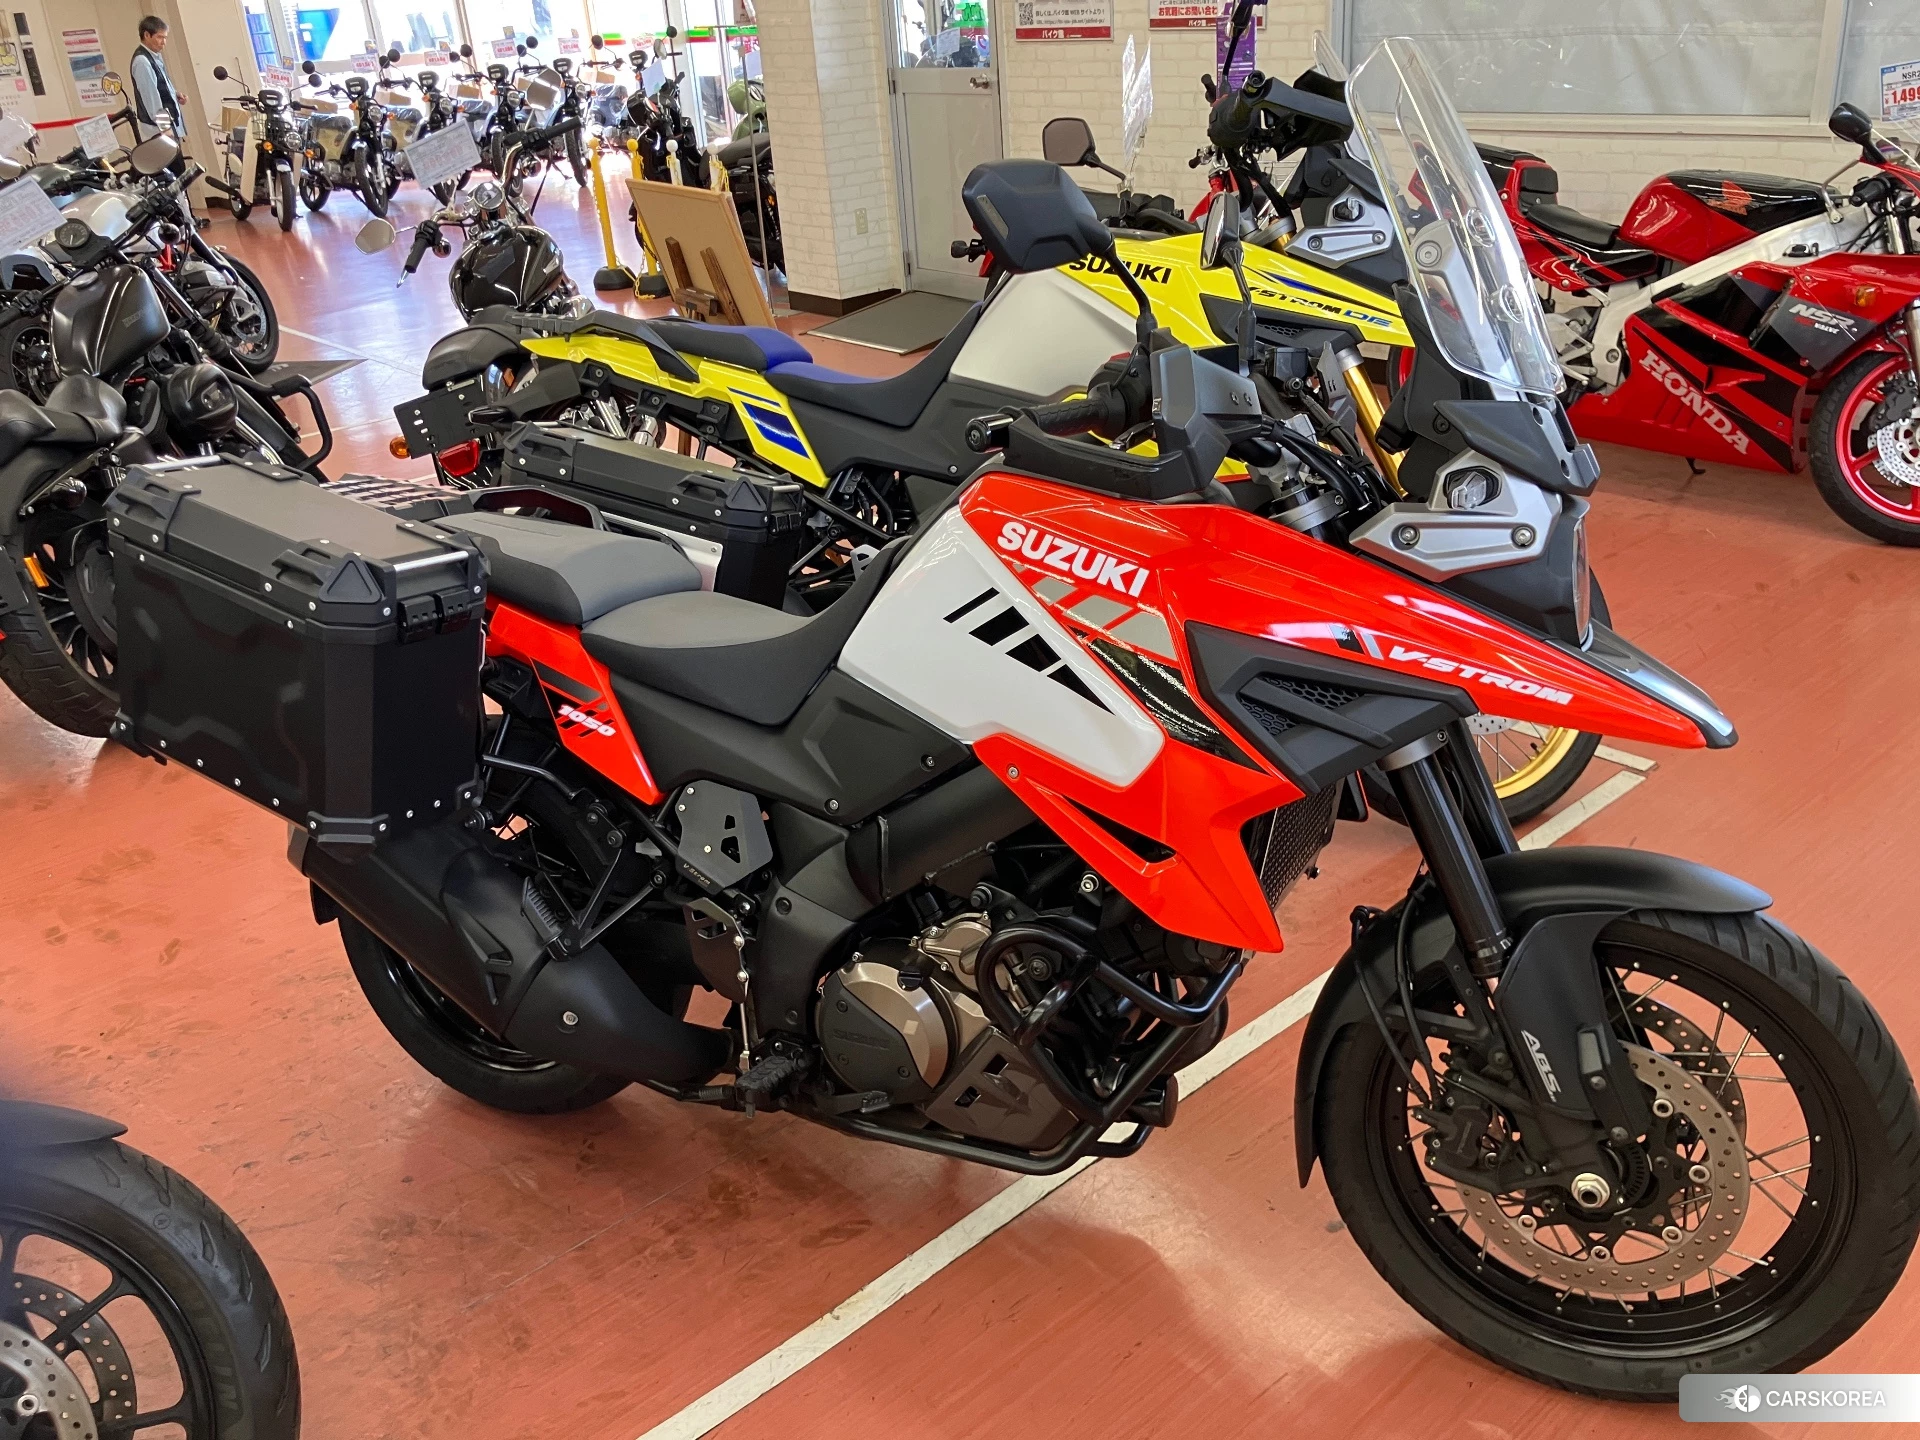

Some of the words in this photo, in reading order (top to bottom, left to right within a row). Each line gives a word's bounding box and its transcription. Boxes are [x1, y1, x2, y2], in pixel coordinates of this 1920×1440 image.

[1343, 309, 1393, 328] DE
[1789, 303, 1855, 330] NSR
[1638, 349, 1749, 455] HONDA
[997, 521, 1149, 598] SUZUKI
[1388, 645, 1574, 706] V-STROM
[557, 704, 617, 737] 1050
[1520, 1029, 1562, 1097] ABS
